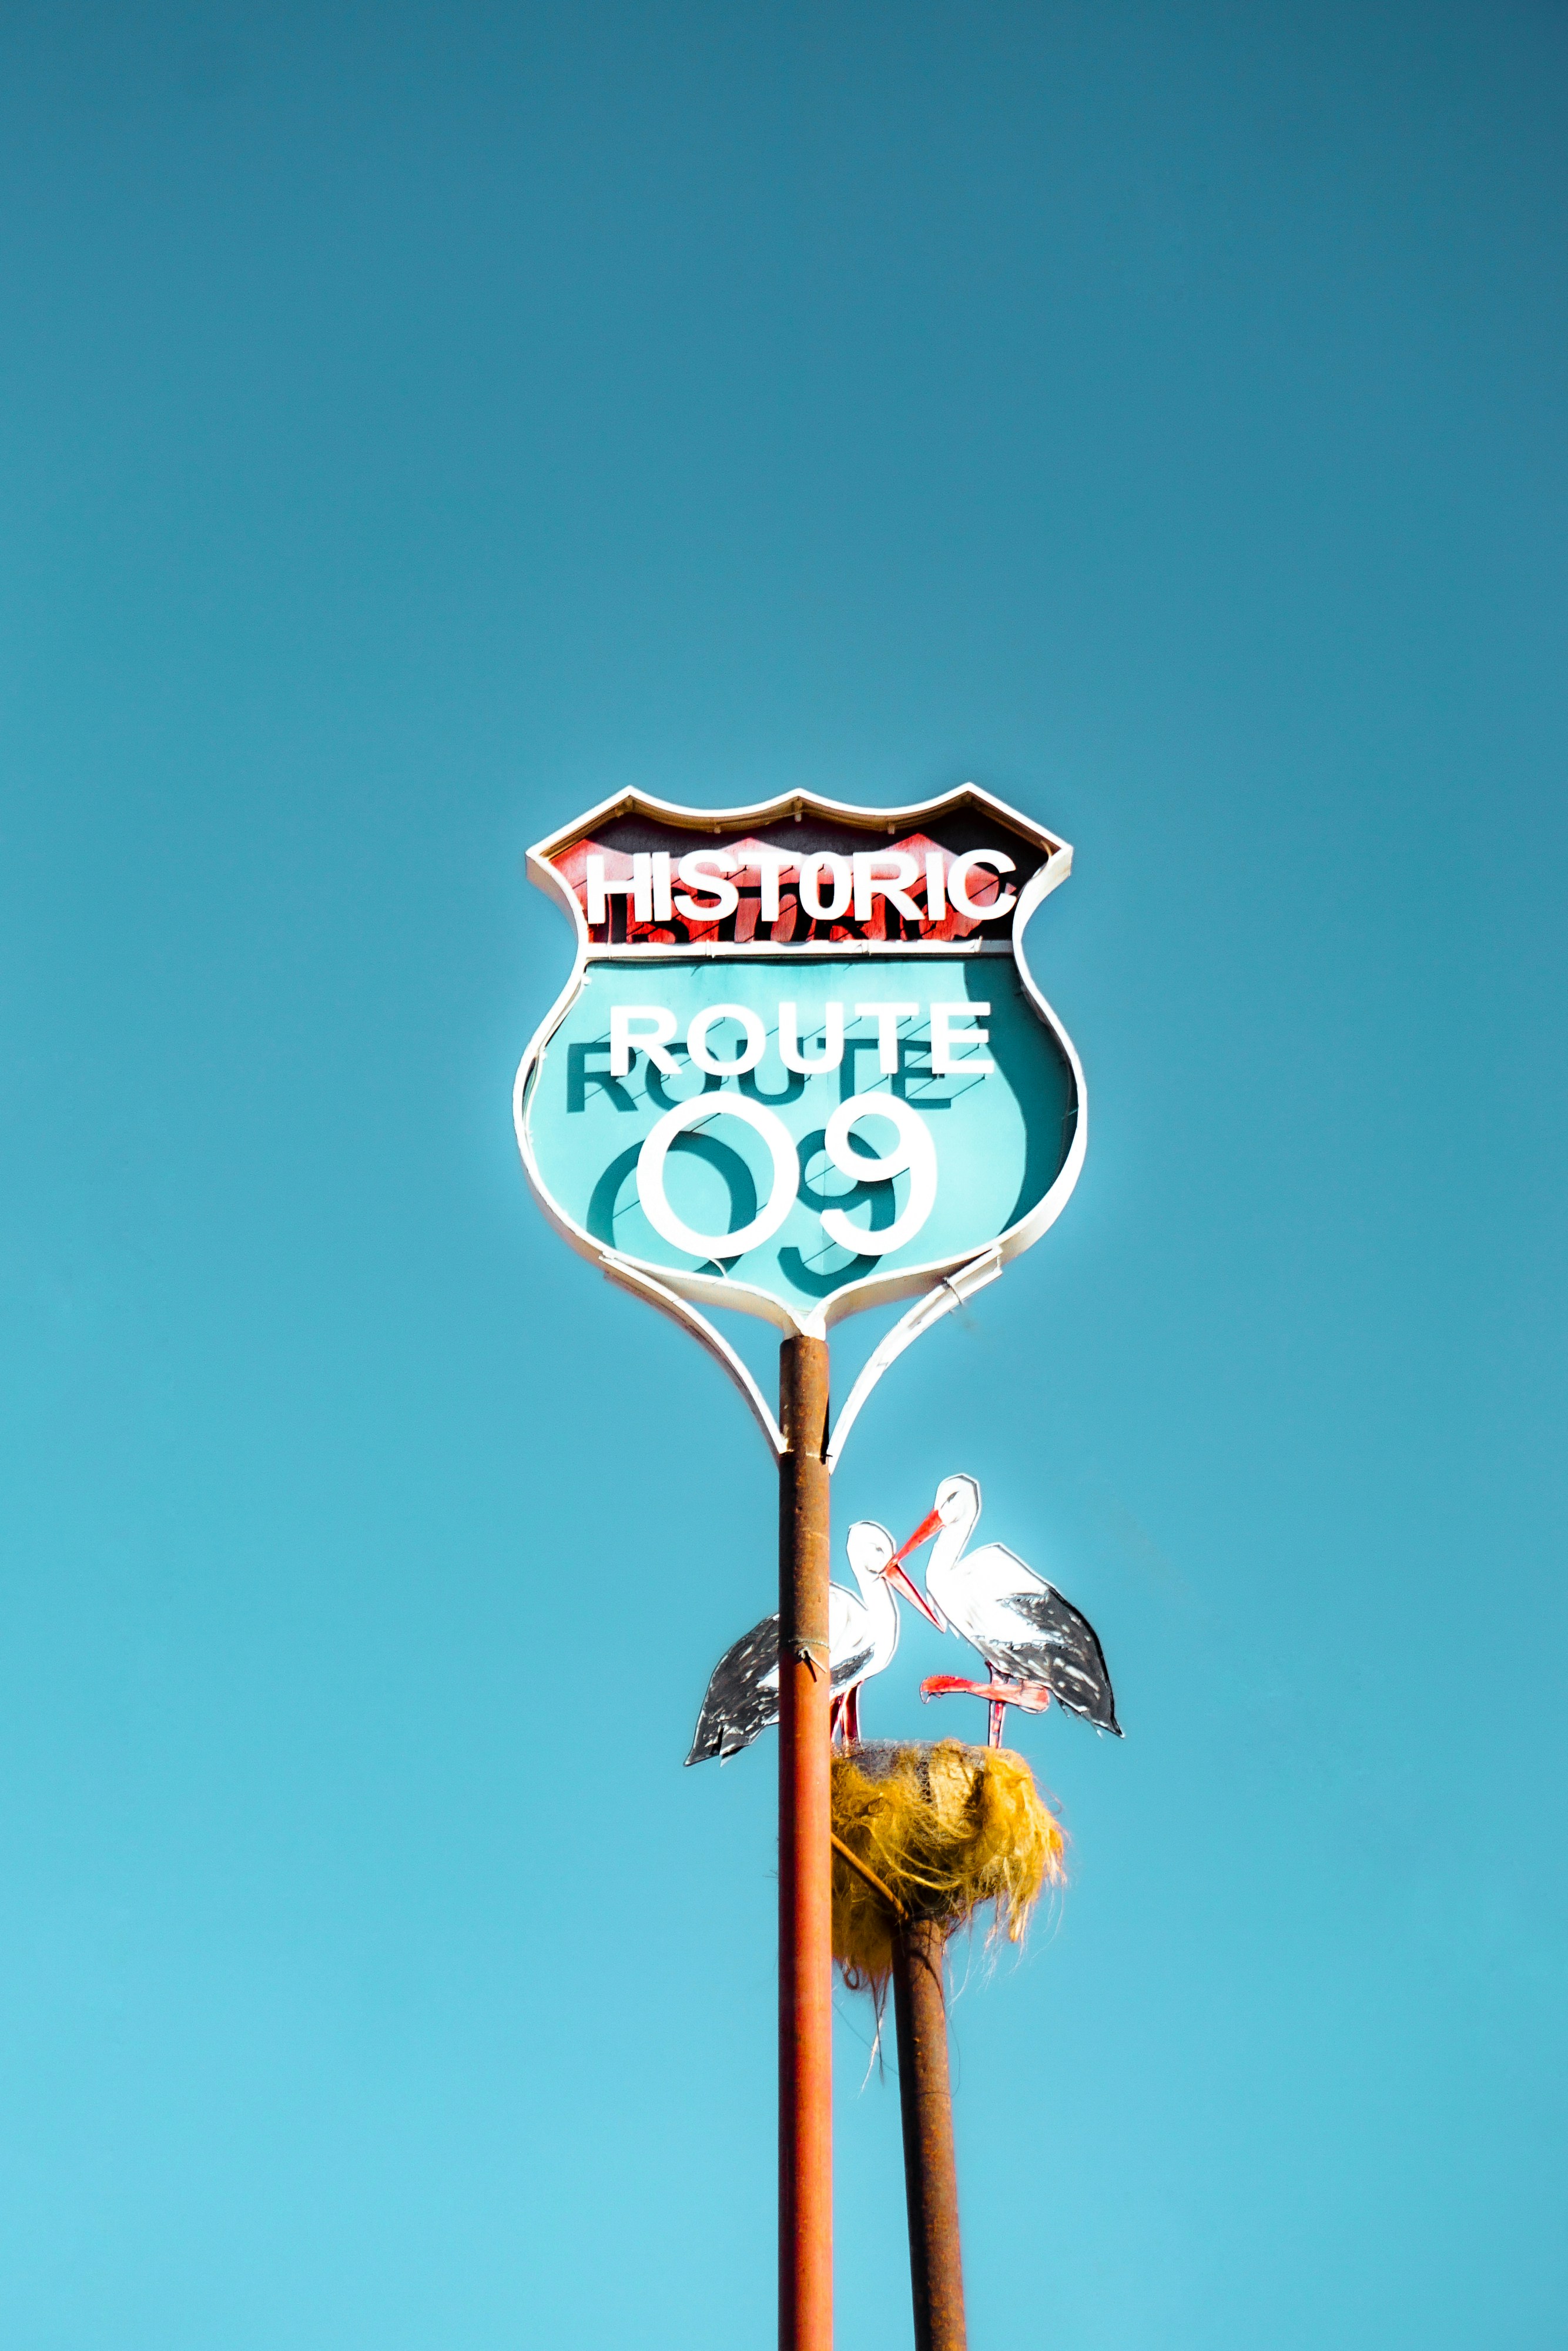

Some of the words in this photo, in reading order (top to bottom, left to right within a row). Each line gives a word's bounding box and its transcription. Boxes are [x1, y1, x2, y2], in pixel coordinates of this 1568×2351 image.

[588, 849, 1017, 925] HISTORIC
[609, 1001, 994, 1077] ROUTE
[636, 1091, 937, 1258] 09
